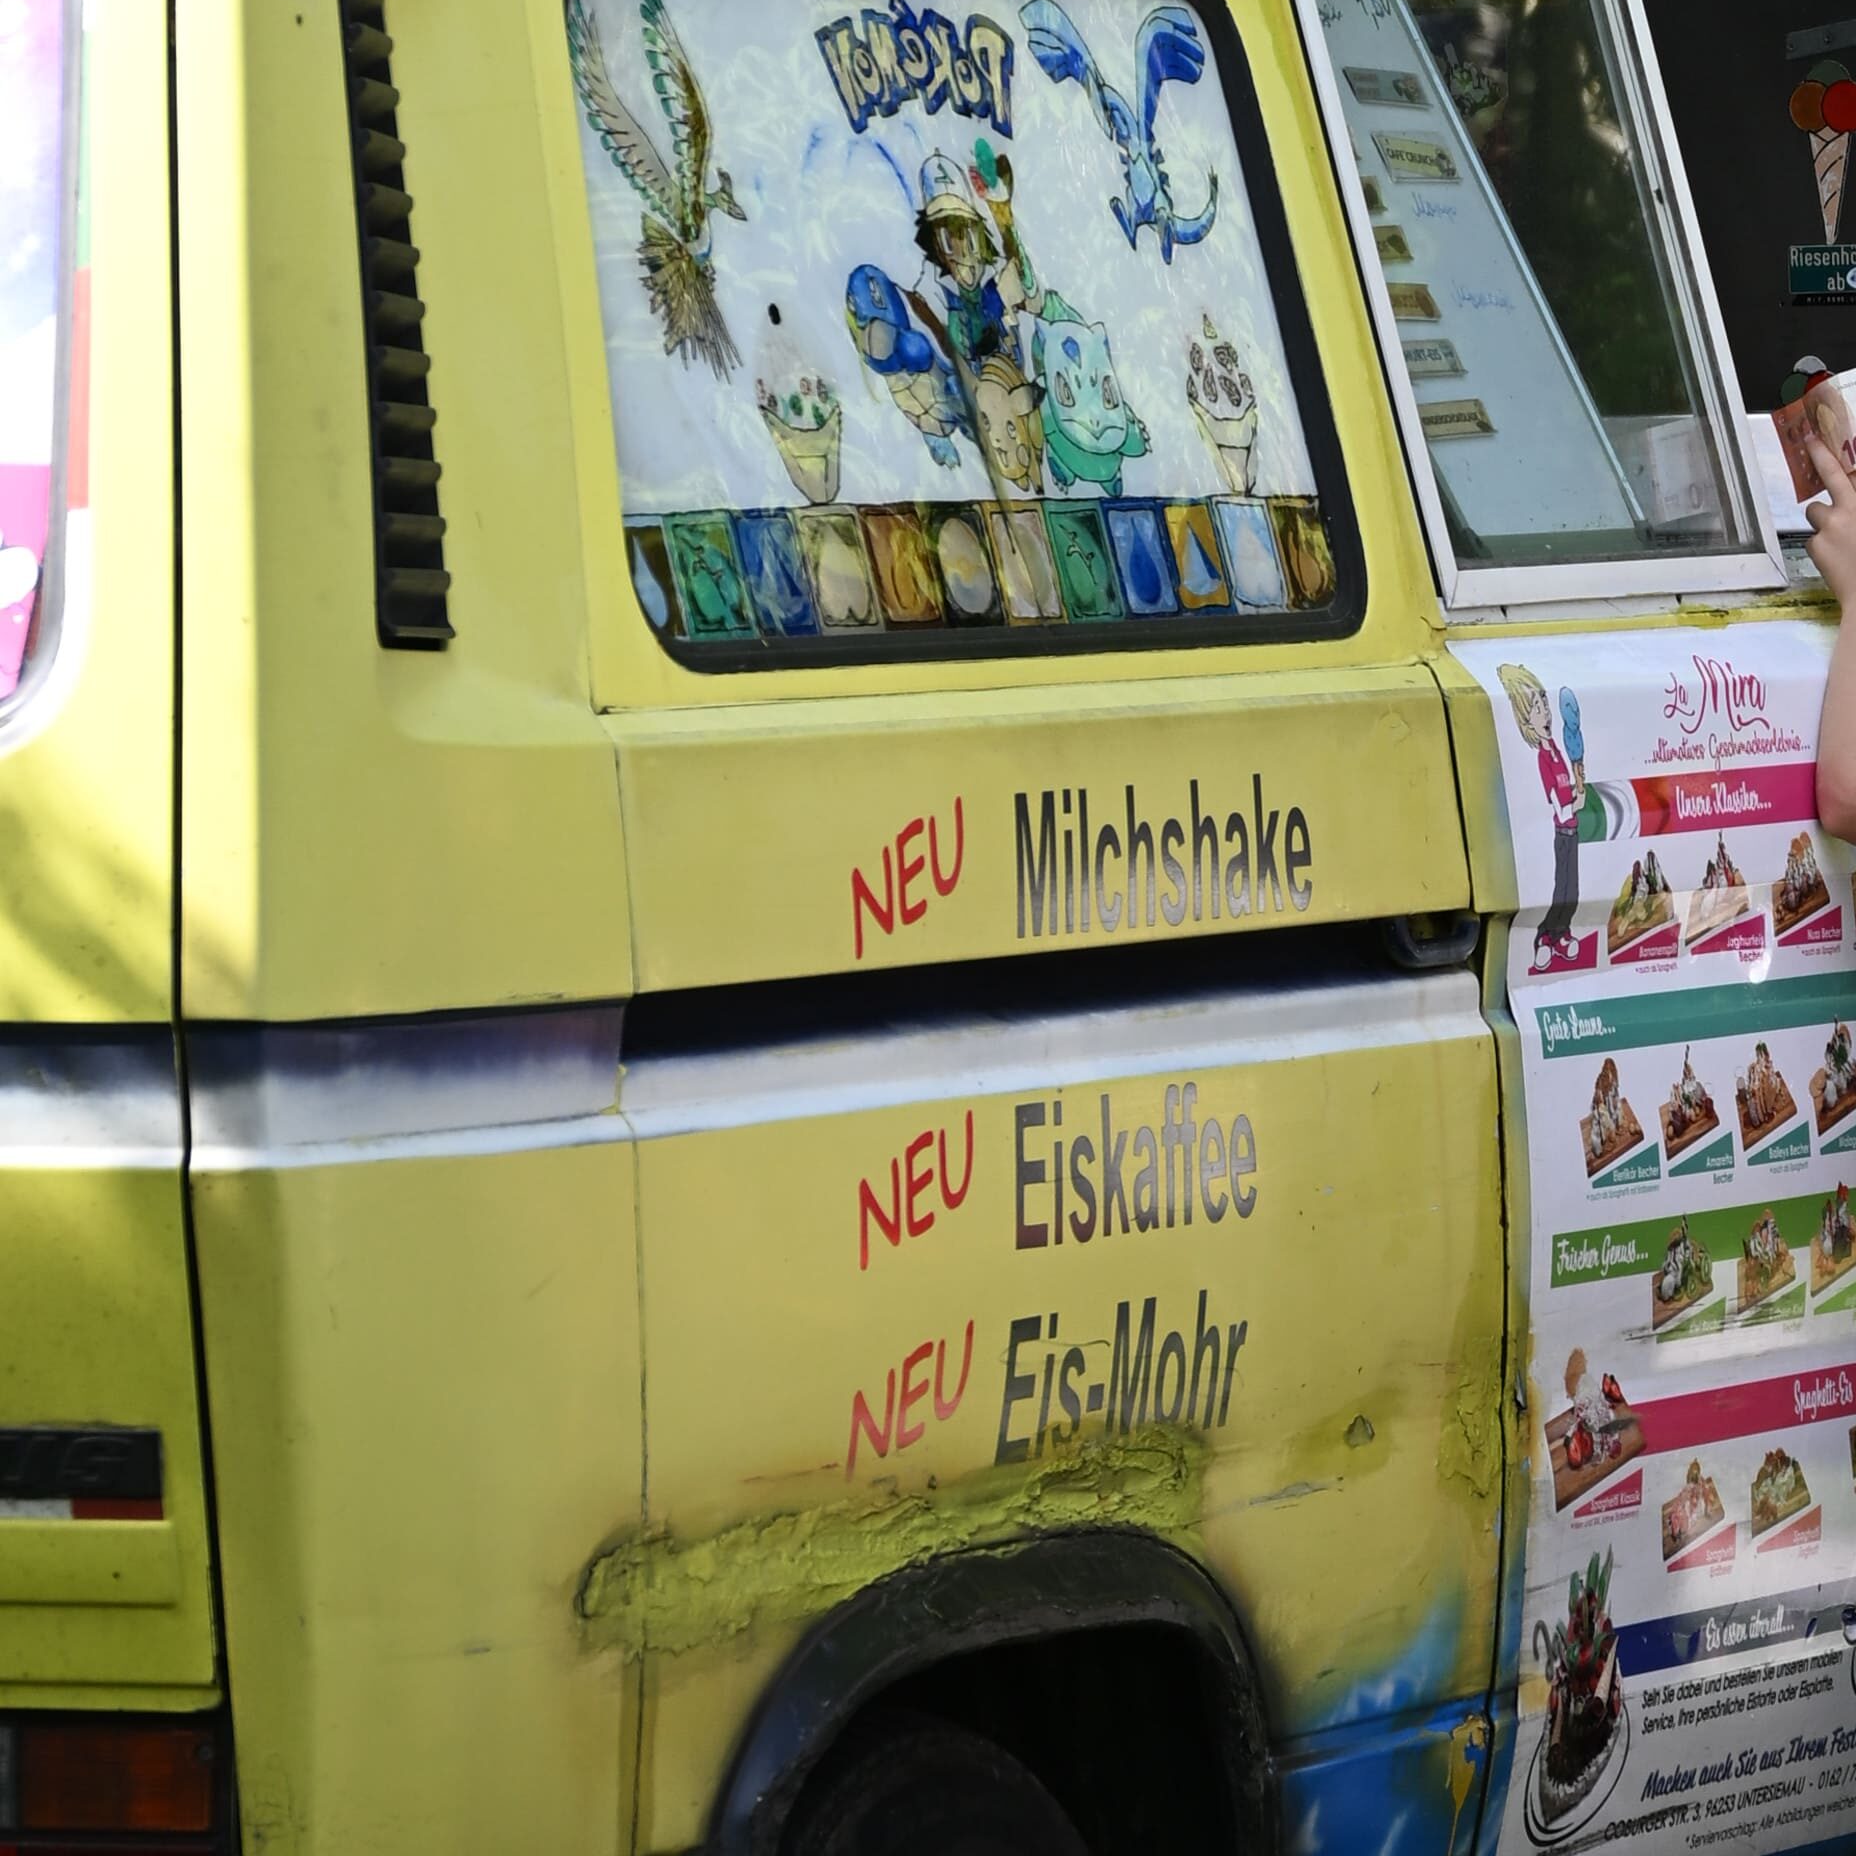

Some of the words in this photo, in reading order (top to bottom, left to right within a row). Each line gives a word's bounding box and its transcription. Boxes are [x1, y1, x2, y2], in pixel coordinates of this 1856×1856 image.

[1827, 271, 1845, 291] ab
[850, 796, 964, 960] NEU
[1014, 773, 1313, 939] Milchshake
[859, 1109, 974, 1271] NEU
[1014, 1081, 1258, 1250] Eiskaffee
[845, 1319, 974, 1482] NEU
[993, 1289, 1248, 1467] Eis-Mohr
[1793, 1370, 1854, 1423] Spaghetti-Eis
[1705, 1616, 1720, 1652] Eis
[1662, 1684, 1674, 1705] Sie
[1676, 1678, 1703, 1701] dabei
[1704, 1674, 1722, 1695] und
[1762, 1661, 1775, 1682] Sie
[1677, 1706, 1695, 1728] Ihre
[1695, 1697, 1745, 1727] persönliche
[1777, 1685, 1799, 1704] oder
[1641, 1764, 1697, 1802] Machen
[1699, 1752, 1732, 1786] auch
[1735, 1746, 1757, 1779] Sie
[1759, 1749, 1783, 1769] aus
[1785, 1732, 1828, 1765] Ihrem
[1704, 1794, 1736, 1818] 96253
[1736, 1775, 1807, 1811] UNTERSIEMAU
[1817, 1766, 1842, 1791] 0162
[1759, 1816, 1775, 1831] Alle
[1775, 1806, 1826, 1829] Abbildungen
